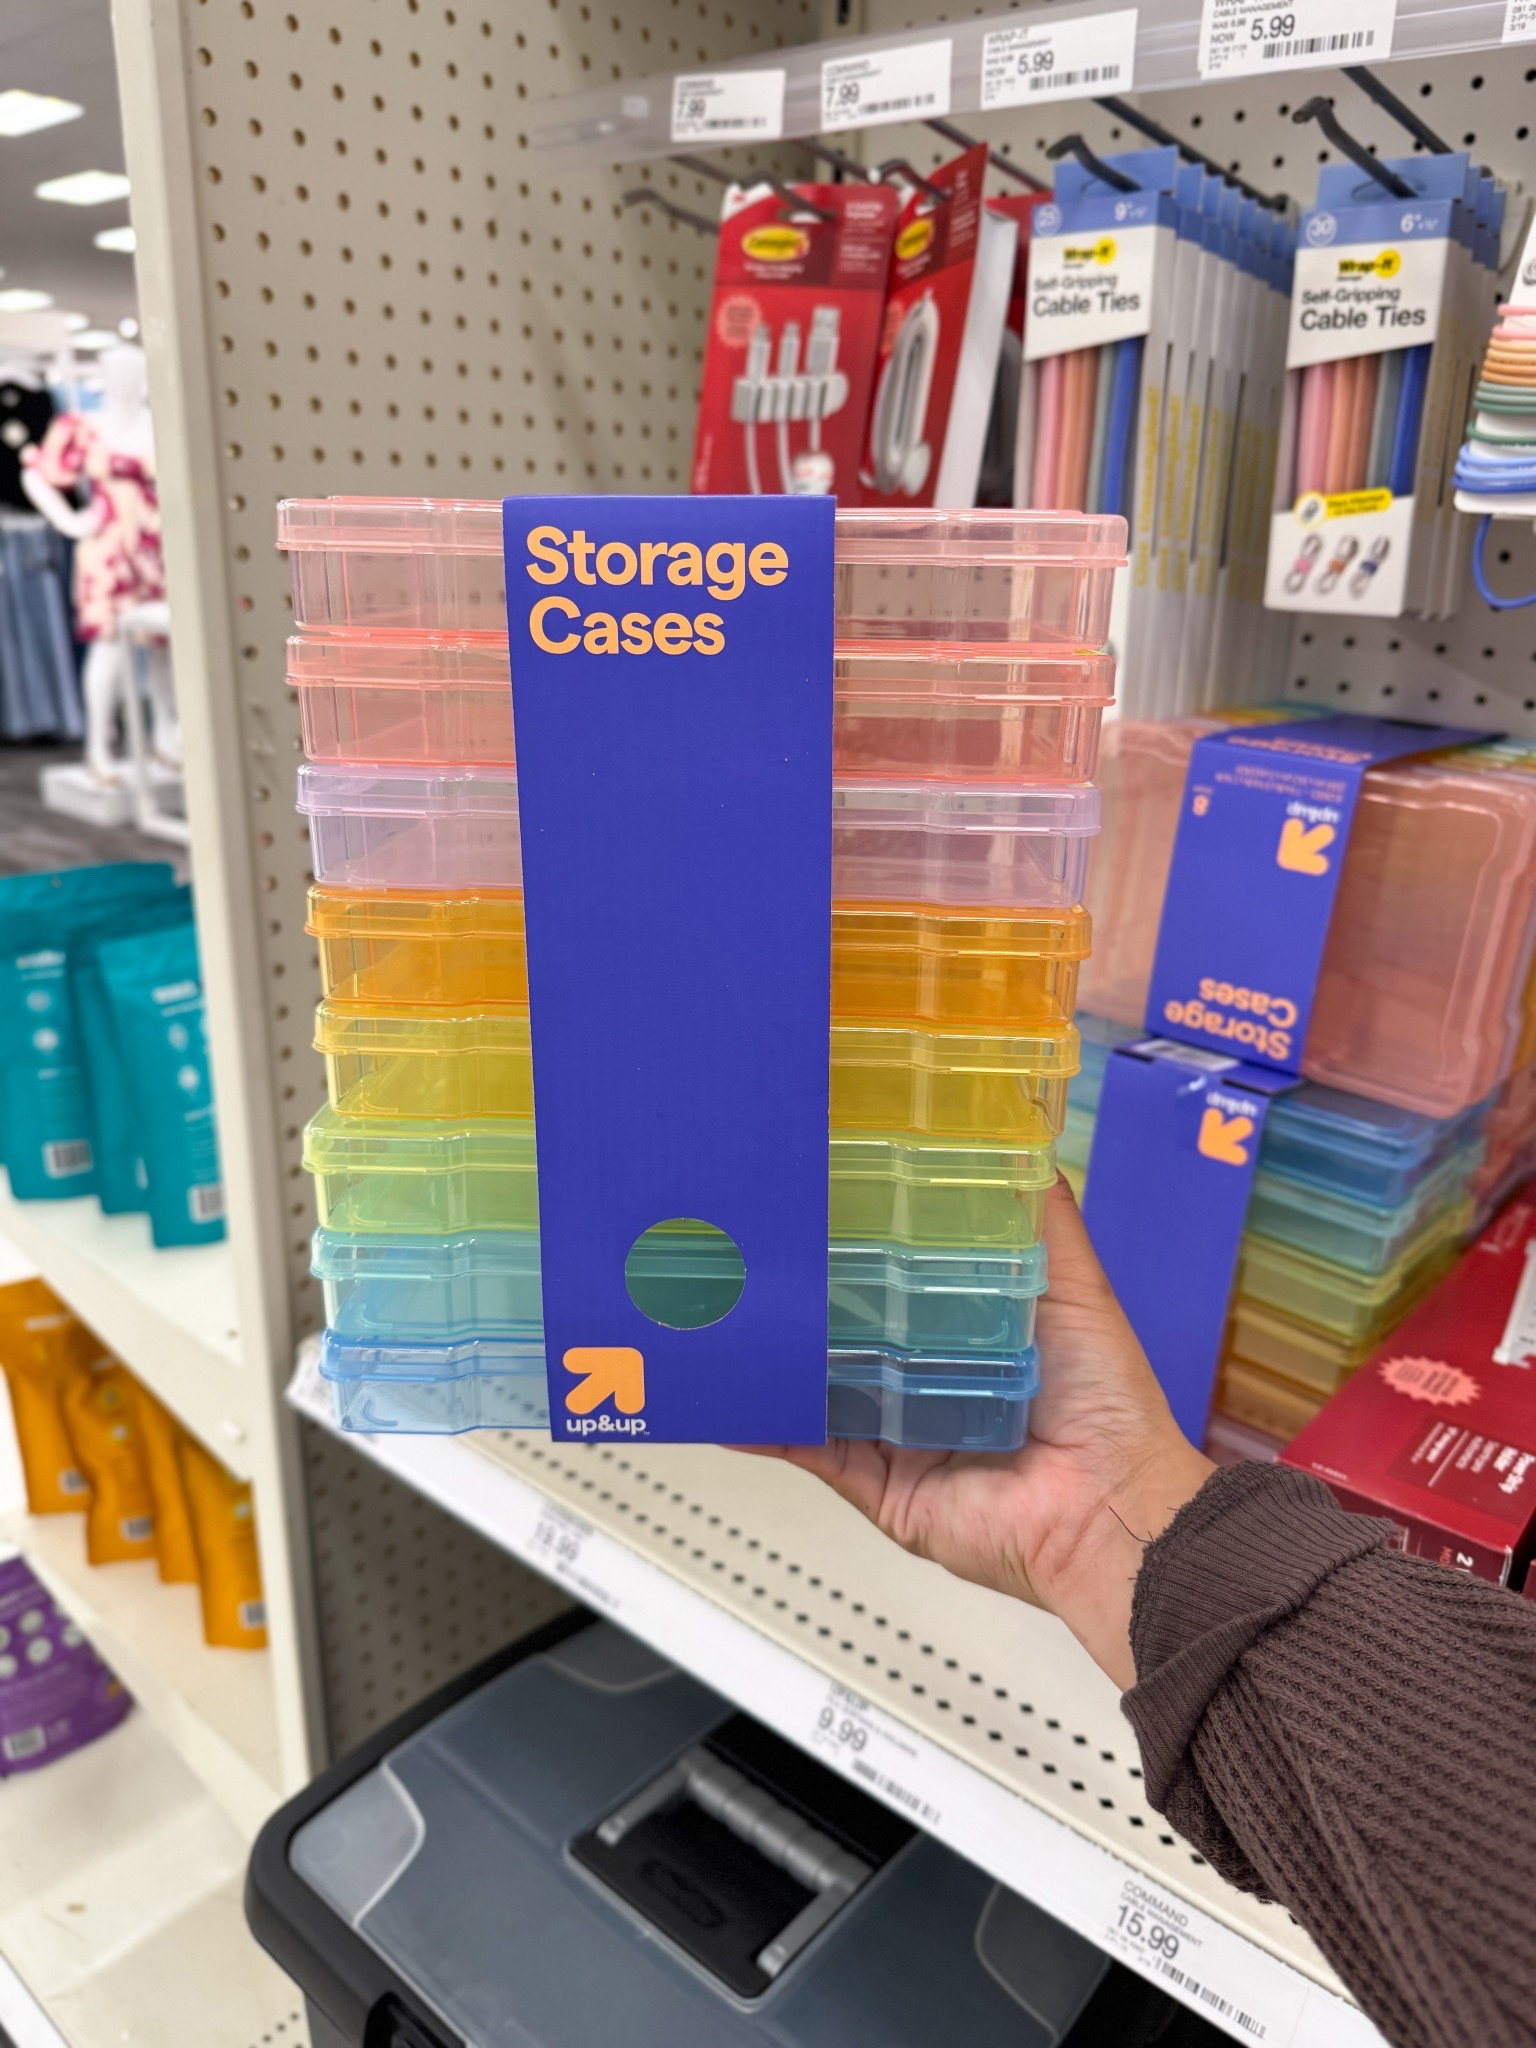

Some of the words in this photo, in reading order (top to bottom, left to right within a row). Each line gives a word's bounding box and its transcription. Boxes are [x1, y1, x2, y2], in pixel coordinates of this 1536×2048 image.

[1209, 32, 1236, 45] NOW
[1250, 14, 1296, 41] 5.99
[1017, 50, 1054, 76] 5.99
[825, 81, 860, 109] 7.99
[1034, 275, 1117, 293] Self-Gripping
[1302, 286, 1400, 304] Self-Gripping
[1033, 296, 1091, 317] Cable
[1097, 292, 1140, 313] Ties
[1300, 307, 1368, 331] Cable
[1376, 305, 1427, 327] Ties
[526, 525, 789, 601] Storage
[529, 595, 726, 656] Cases
[1198, 977, 1297, 1029] Cases
[1164, 999, 1292, 1060] Storage
[566, 1414, 647, 1437] up&up
[817, 1706, 868, 1752] 9.99
[1123, 1880, 1189, 1928] COMMAND
[1117, 1904, 1180, 1960] 15.99
